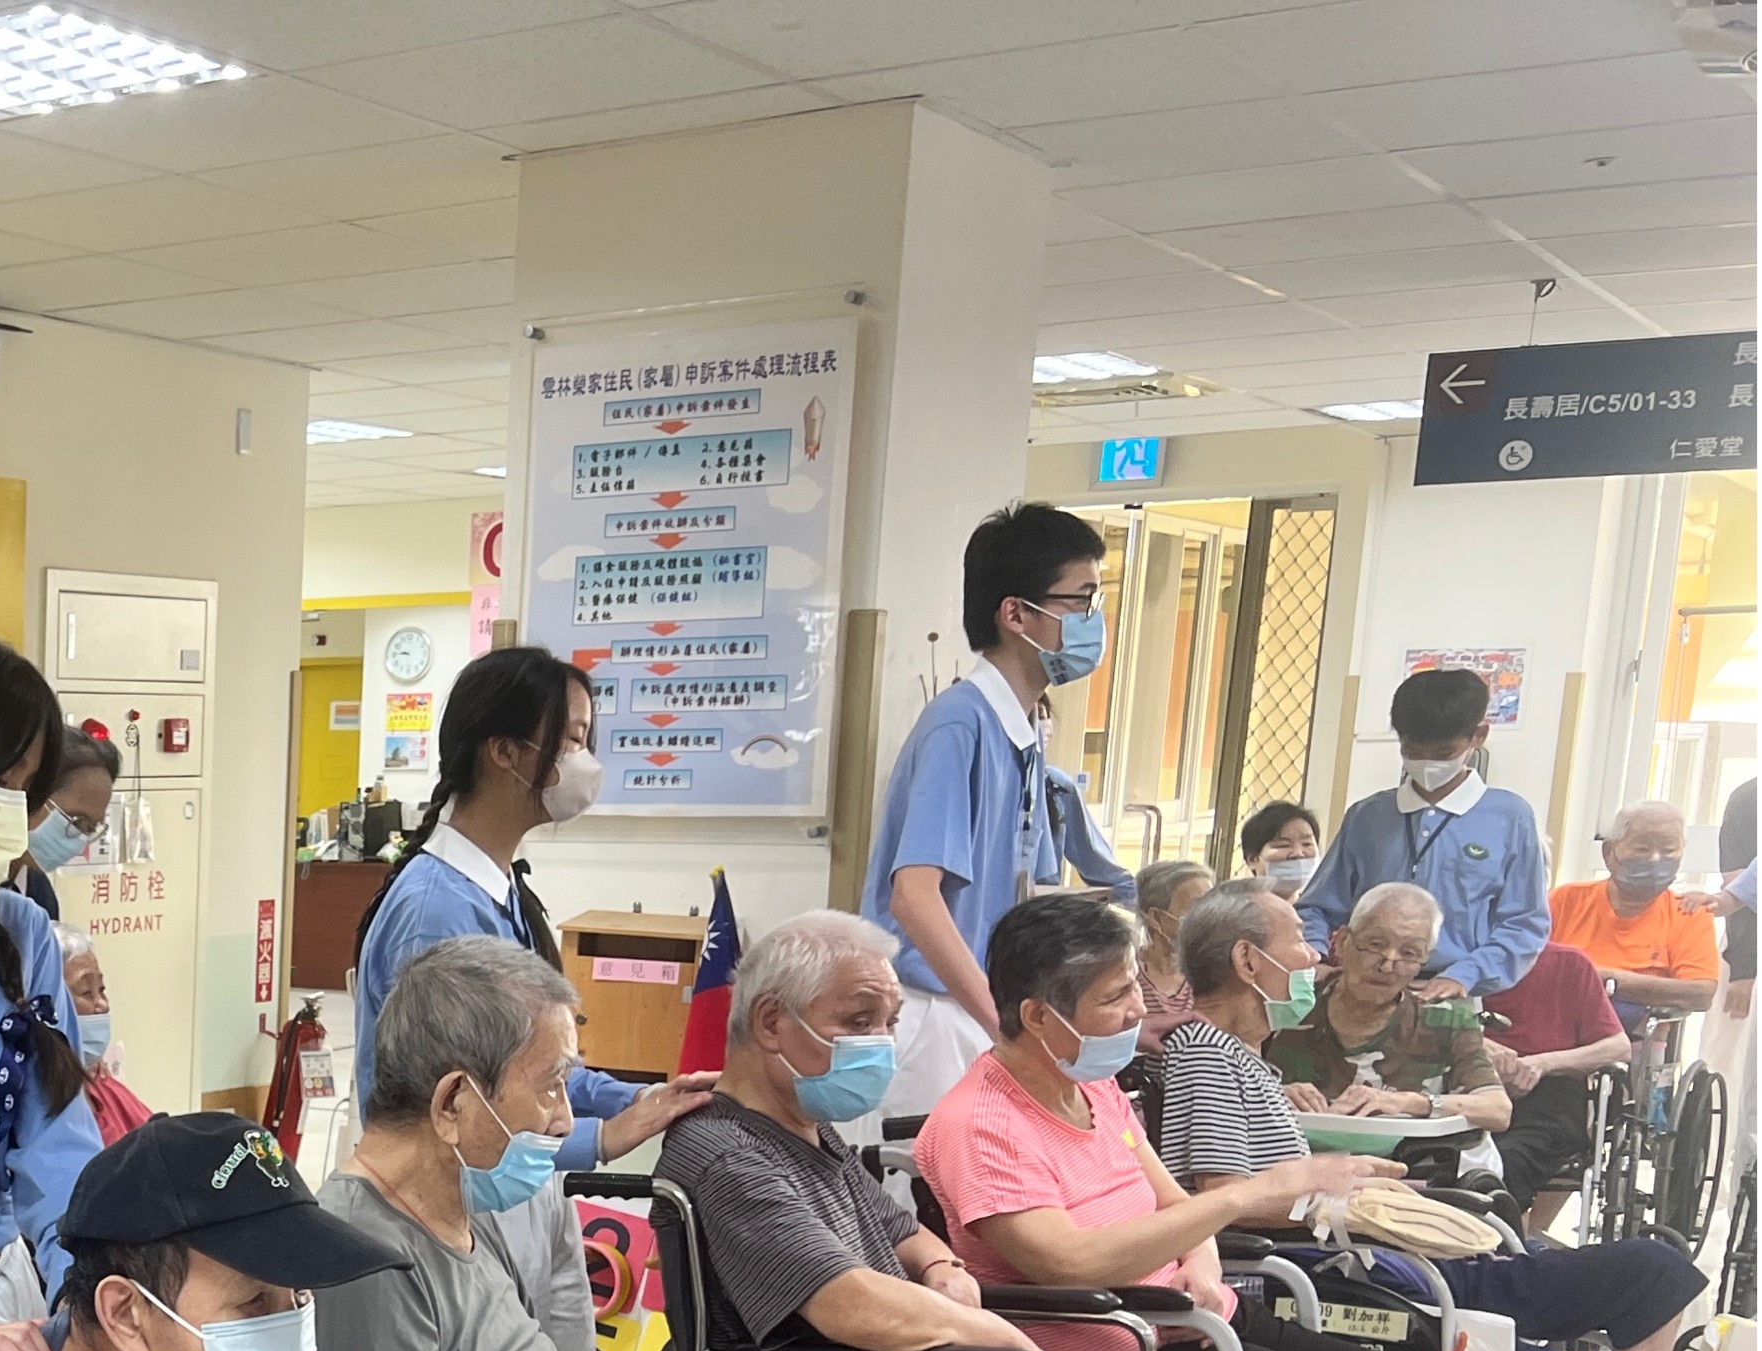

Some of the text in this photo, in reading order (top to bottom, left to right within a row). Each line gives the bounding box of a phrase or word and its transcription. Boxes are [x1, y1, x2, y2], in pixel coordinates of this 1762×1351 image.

[1503, 389, 1697, 421] 長壽居/C5/01-33
[1669, 436, 1744, 460] 仁愛堂
[91, 871, 166, 904] 消防栓
[90, 914, 164, 935] HYDRANT
[258, 919, 273, 984] 滅火器
[598, 961, 676, 981] 意見箱
